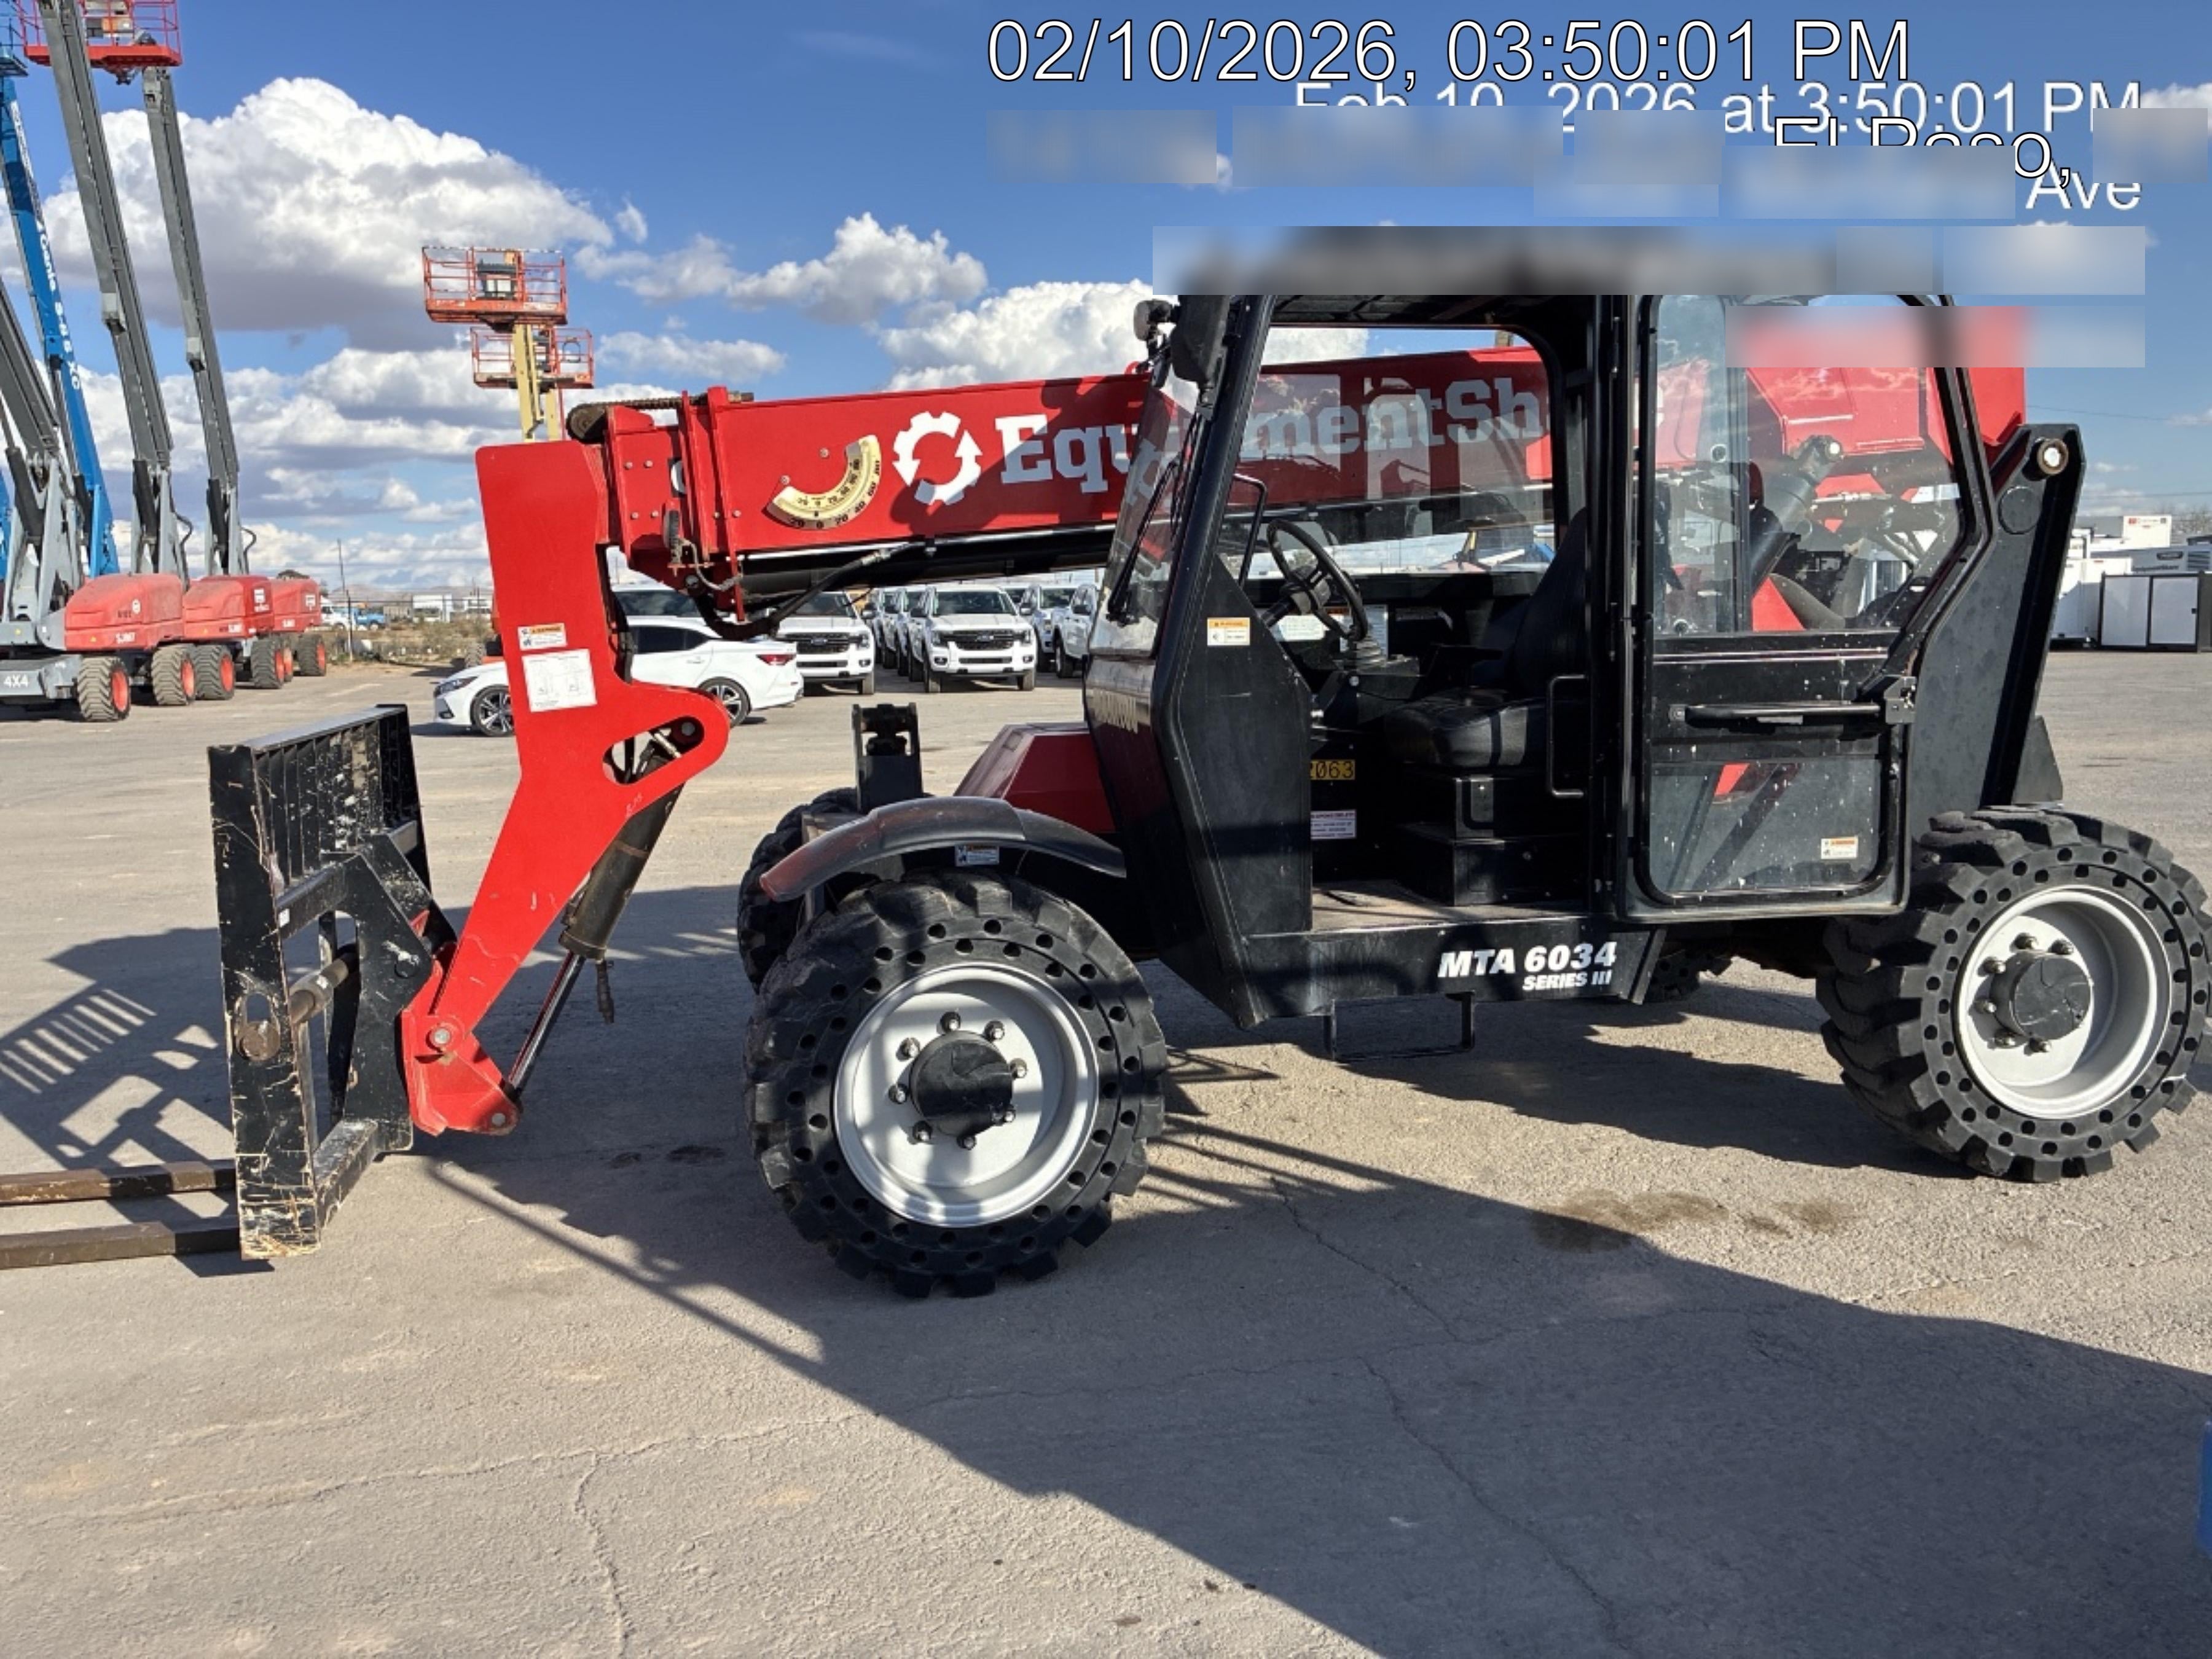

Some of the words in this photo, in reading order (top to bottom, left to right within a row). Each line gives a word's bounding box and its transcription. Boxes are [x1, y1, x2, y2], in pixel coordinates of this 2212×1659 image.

[3, 674, 29, 688] 4X4
[1437, 948, 1516, 978] MTA
[1523, 941, 1618, 973] 6034
[1522, 971, 1588, 991] SERIES
